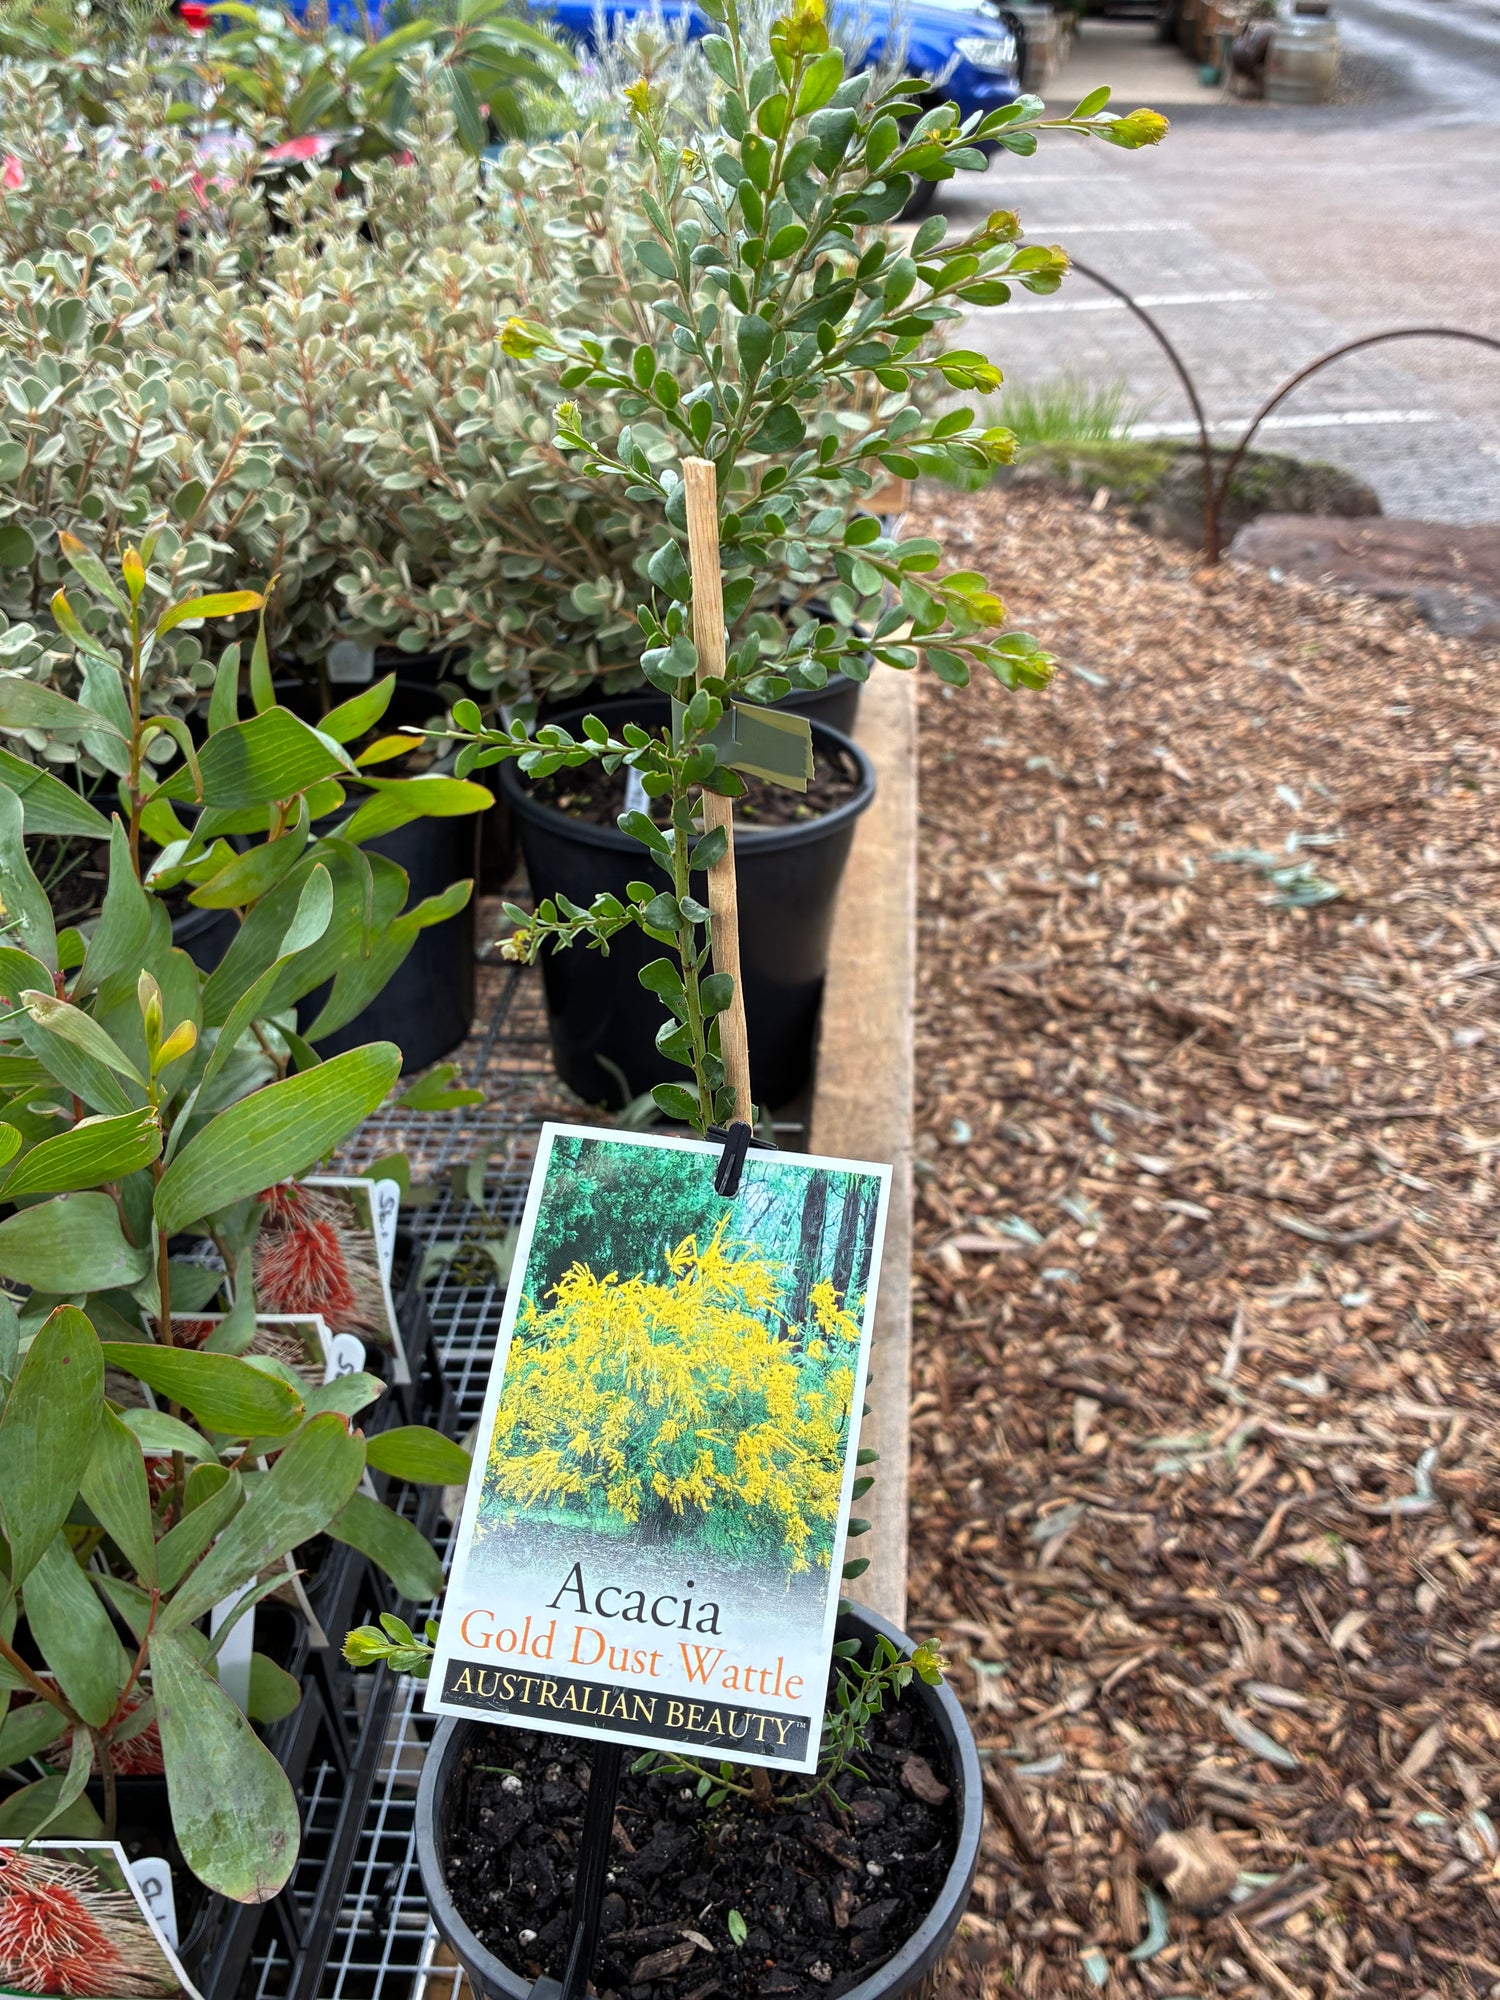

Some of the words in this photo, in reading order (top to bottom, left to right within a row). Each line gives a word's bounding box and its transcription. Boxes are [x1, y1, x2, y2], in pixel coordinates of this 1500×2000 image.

[545, 1561, 722, 1635] Acacia
[460, 1609, 557, 1660] Gold
[567, 1625, 664, 1677] Dust
[678, 1642, 804, 1700] Wattle
[451, 1667, 659, 1724] AUSTRALIAN
